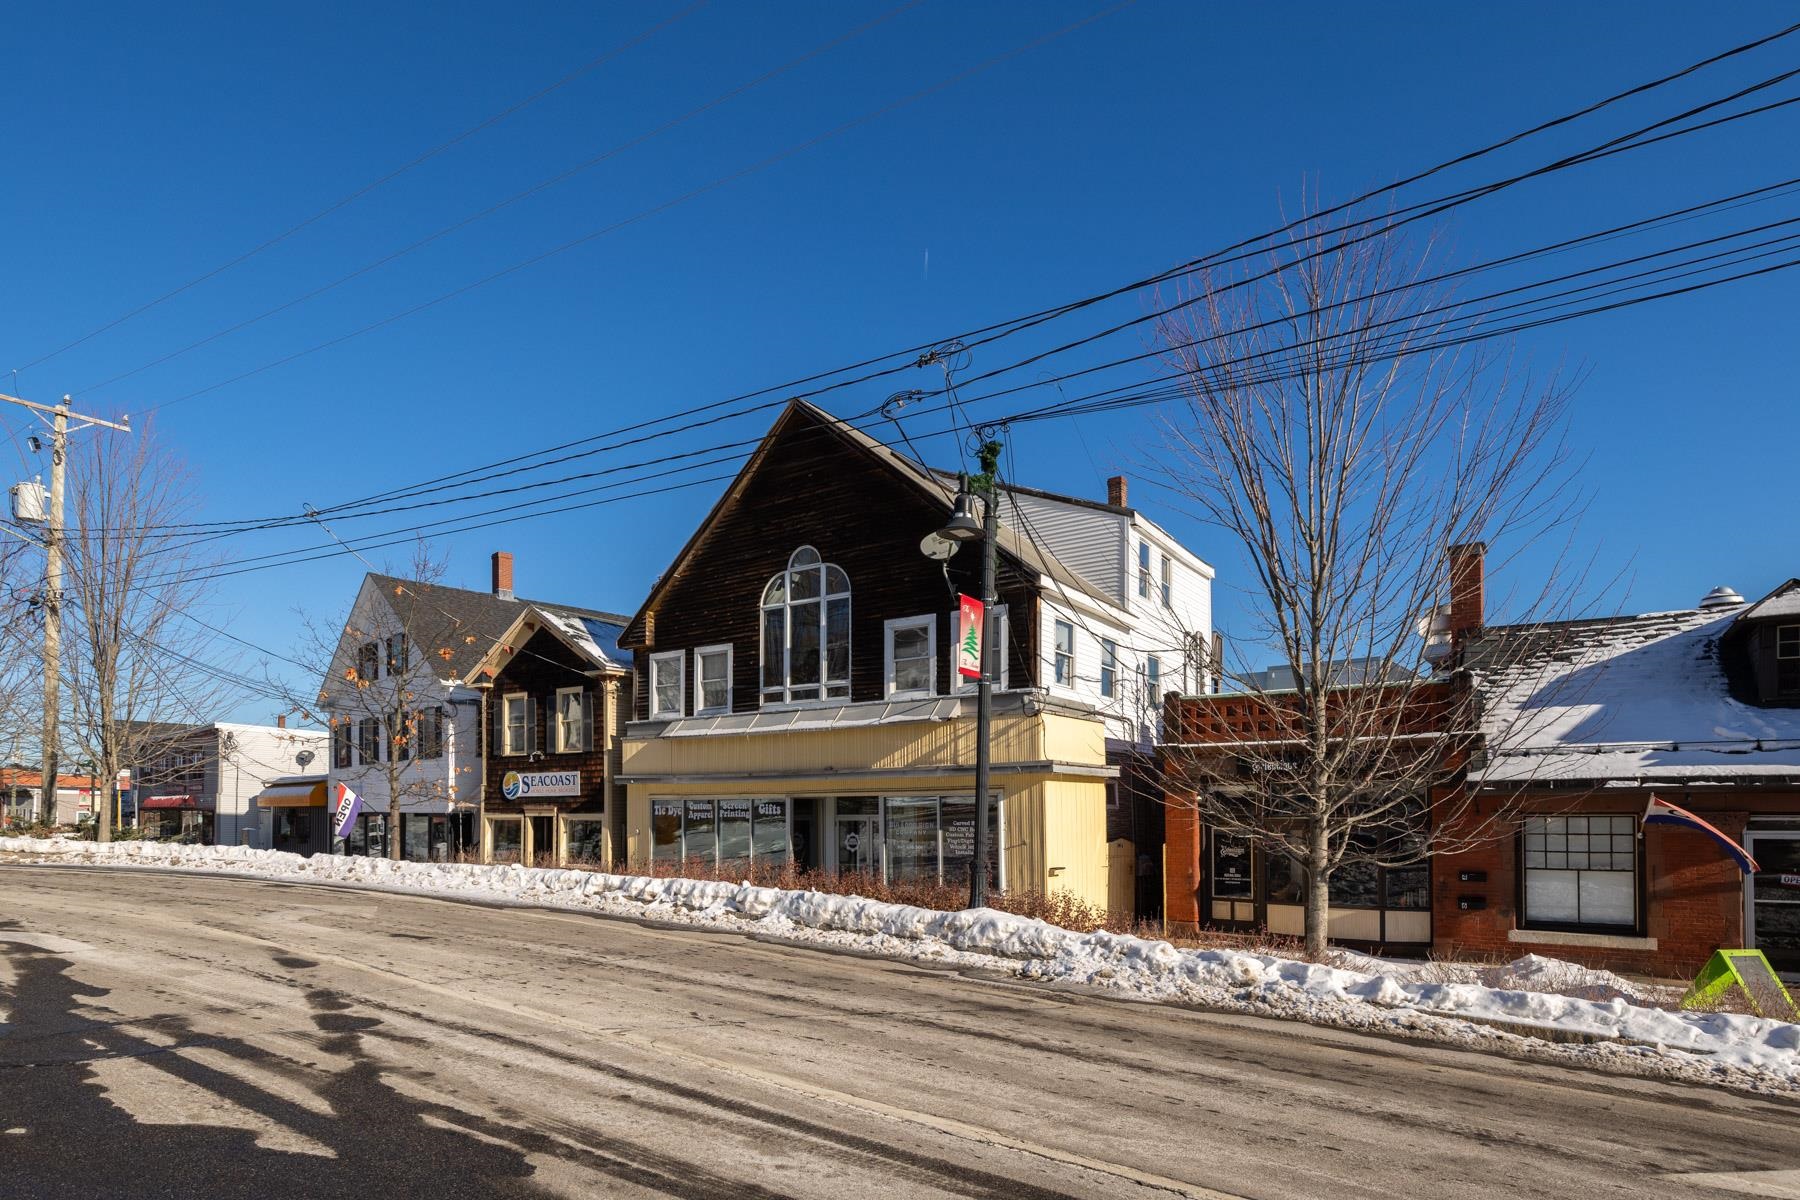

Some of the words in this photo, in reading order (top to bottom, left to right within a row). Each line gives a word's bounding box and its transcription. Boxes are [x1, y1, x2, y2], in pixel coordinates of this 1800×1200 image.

[522, 774, 578, 794] SEACOAST
[689, 802, 712, 810] Custom
[722, 801, 747, 809] Screen
[758, 803, 781, 815] Gifts
[688, 811, 713, 820] Apparel
[720, 809, 750, 818] Printing
